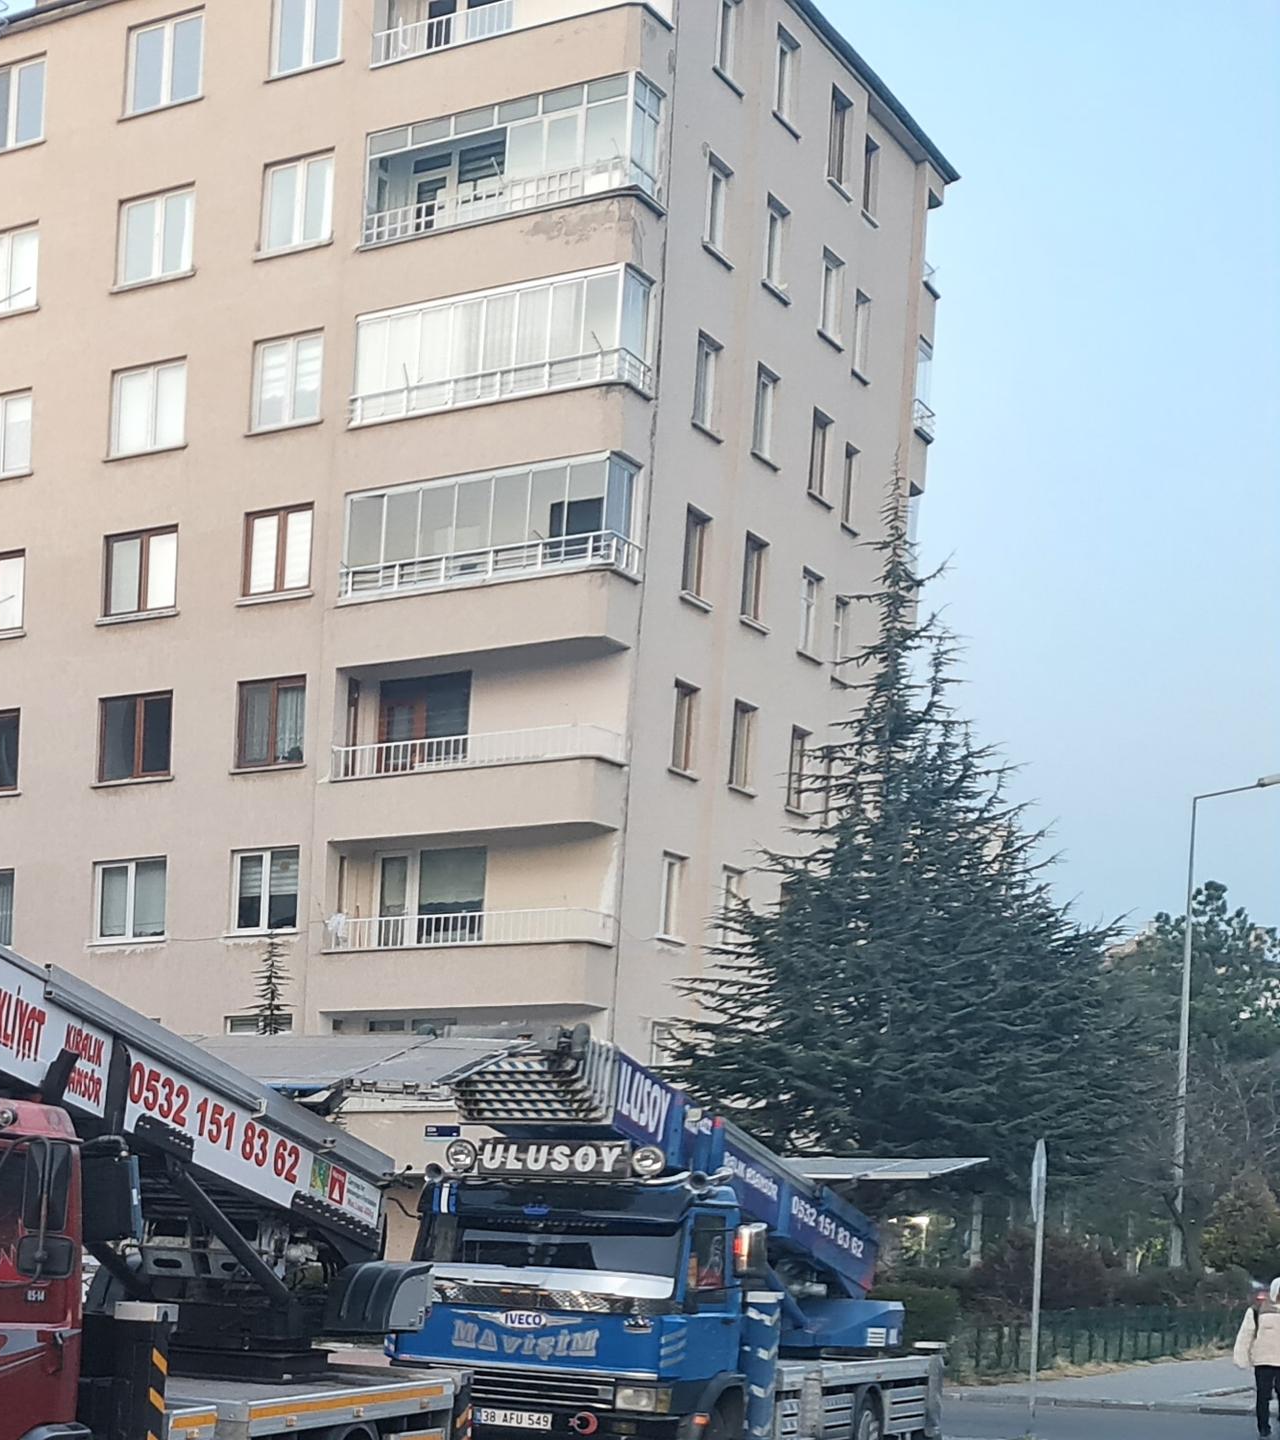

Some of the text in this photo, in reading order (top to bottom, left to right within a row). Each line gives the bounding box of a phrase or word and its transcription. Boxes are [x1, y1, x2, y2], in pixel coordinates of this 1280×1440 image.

[129, 1061, 301, 1185] 0532 151 83 62
[482, 1143, 623, 1173] ULUSOY
[792, 1195, 864, 1258] 0532 151 83 62
[504, 1313, 543, 1326] IVECO
[482, 1409, 550, 1427] 38 AFU 549
